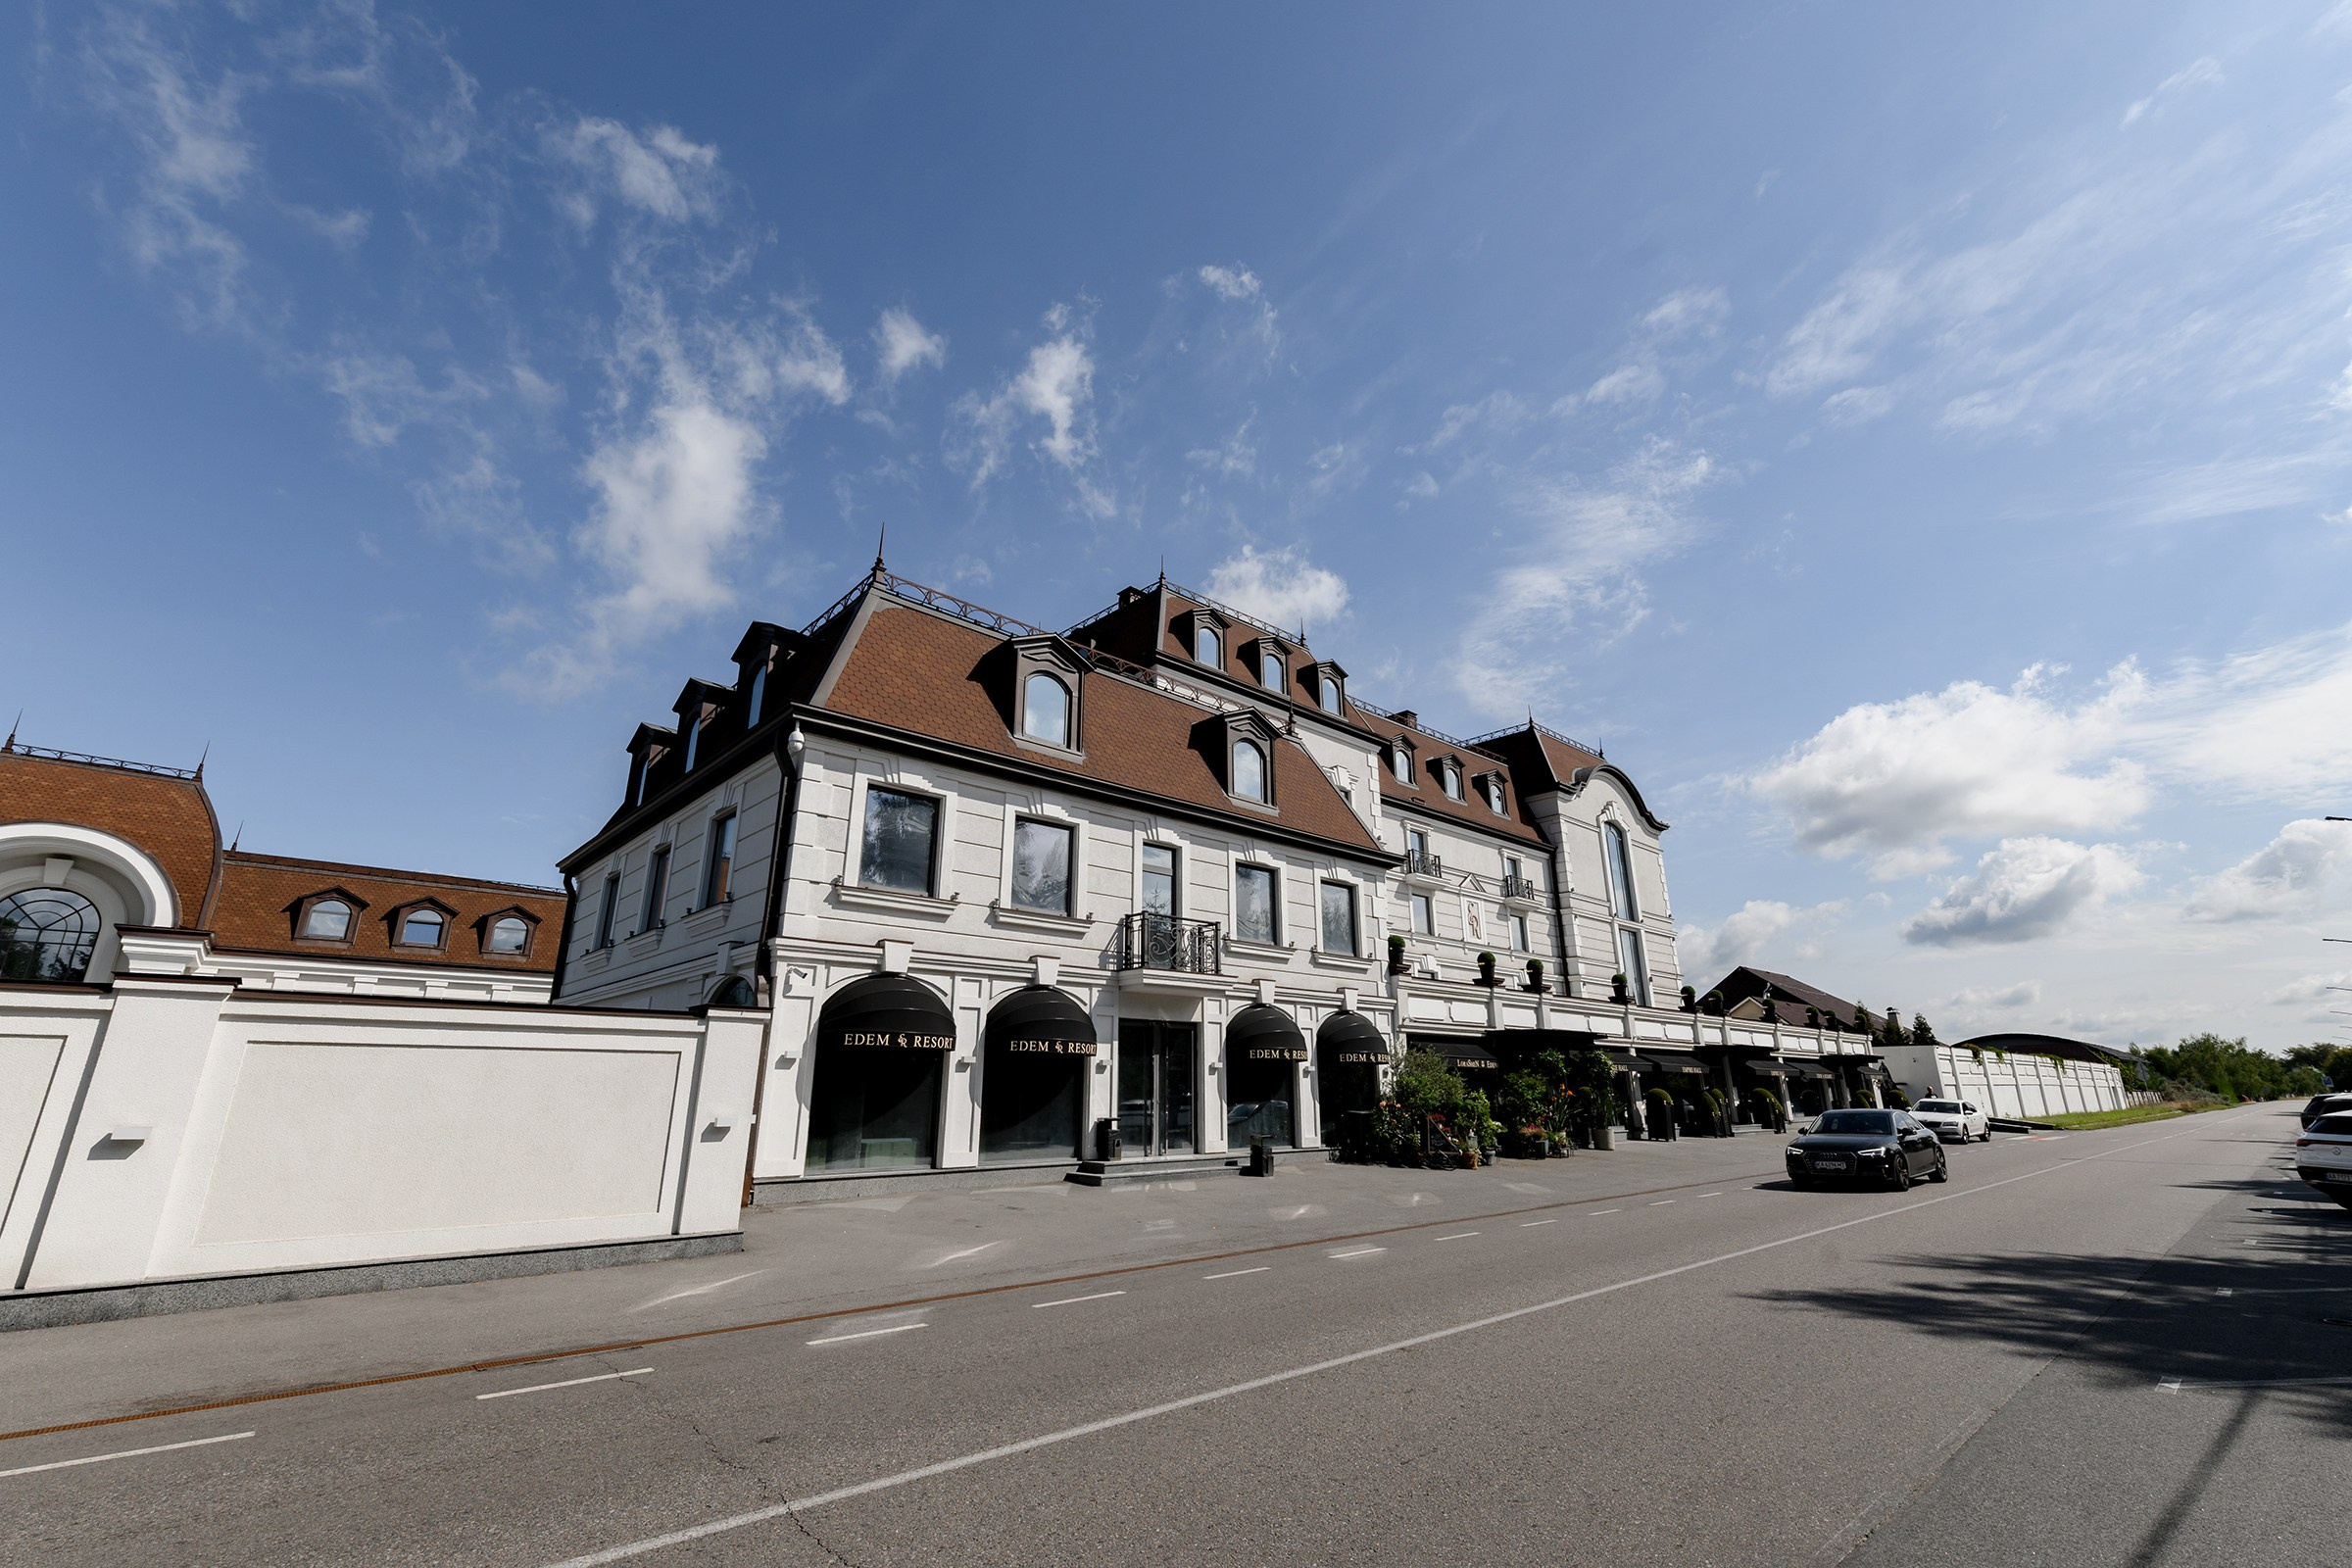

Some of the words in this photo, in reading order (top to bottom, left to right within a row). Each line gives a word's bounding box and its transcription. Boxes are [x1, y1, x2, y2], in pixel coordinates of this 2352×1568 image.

[844, 1034, 890, 1046] EDEM
[913, 1035, 954, 1049] RESORT
[1010, 1041, 1050, 1052] EDEM
[1250, 1050, 1280, 1058] EDEM
[1339, 1054, 1367, 1062] EDEM
